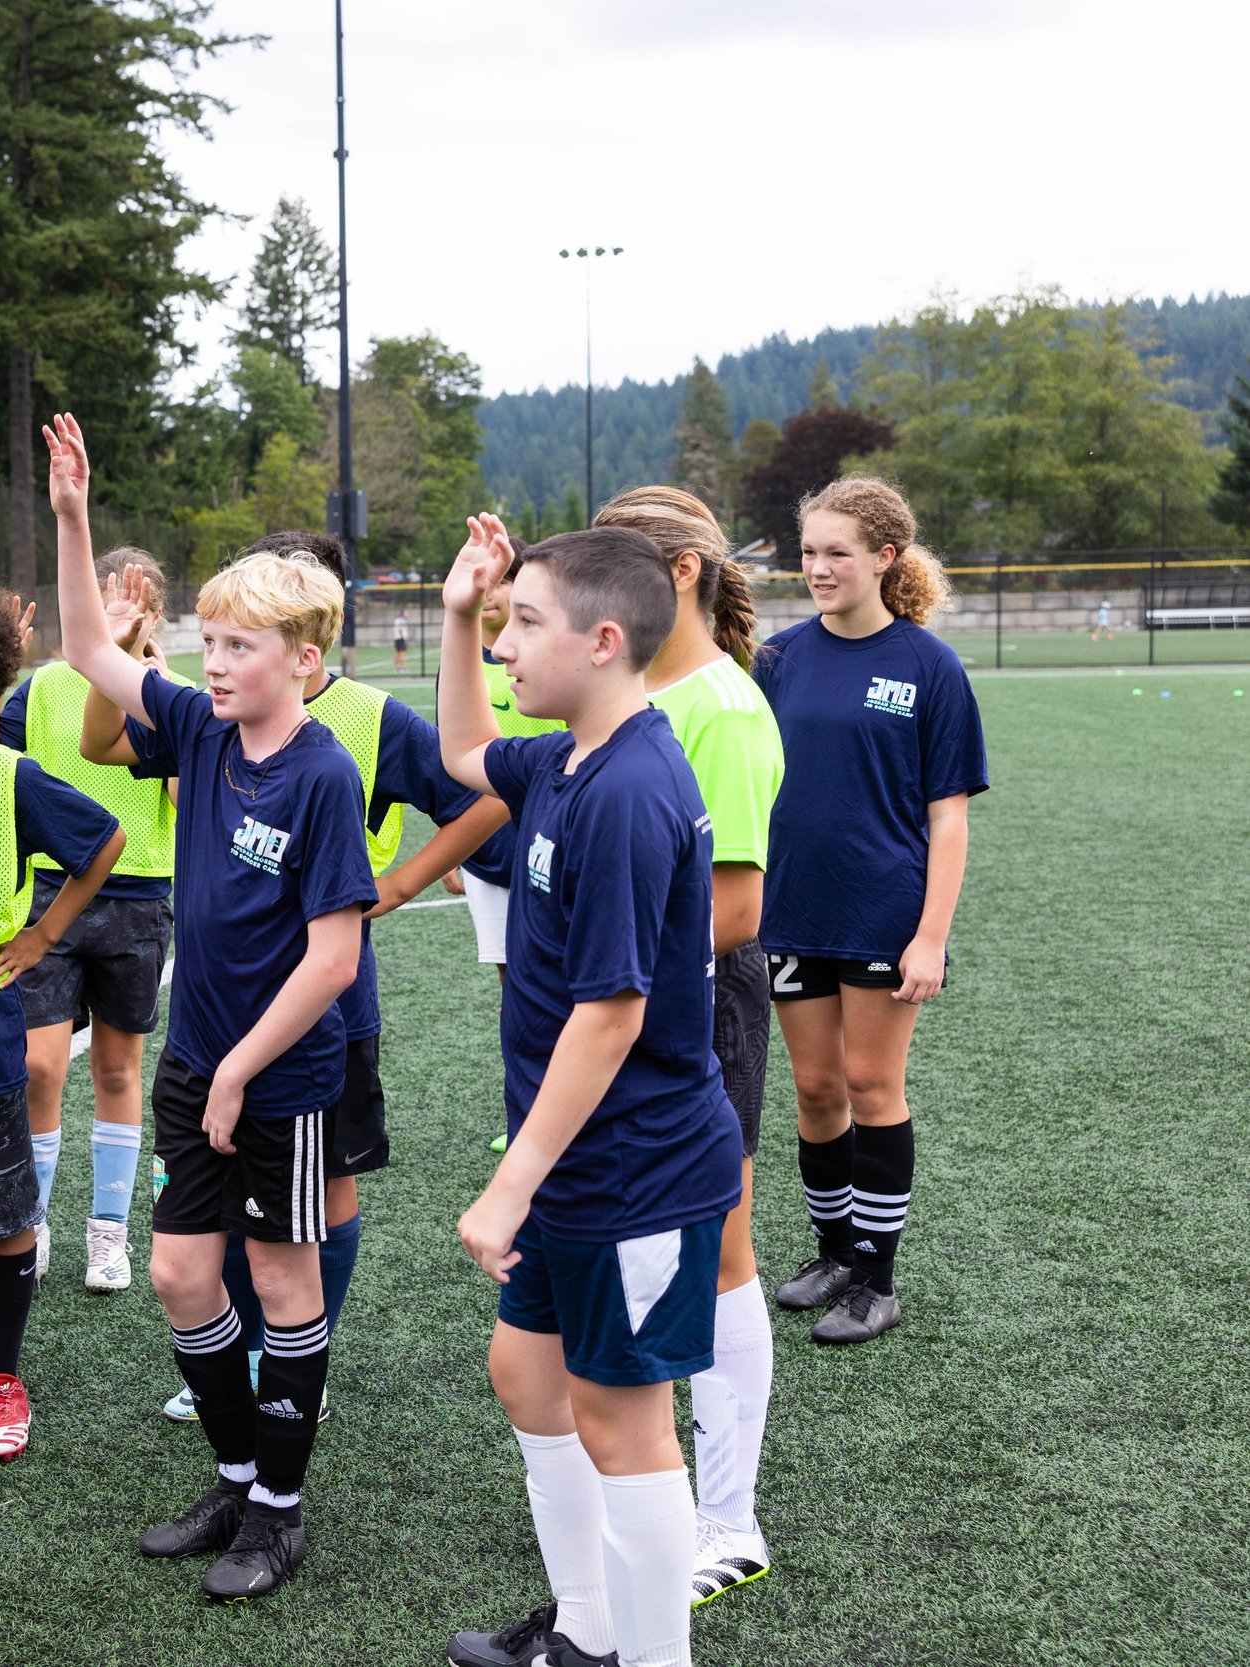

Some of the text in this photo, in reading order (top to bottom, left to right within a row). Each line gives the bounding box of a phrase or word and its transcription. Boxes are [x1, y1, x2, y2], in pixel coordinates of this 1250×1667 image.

[239, 853, 261, 869] SOCCER
[262, 864, 281, 876] CAMP
[867, 964, 892, 972] adidas
[259, 1402, 304, 1419] adidas
